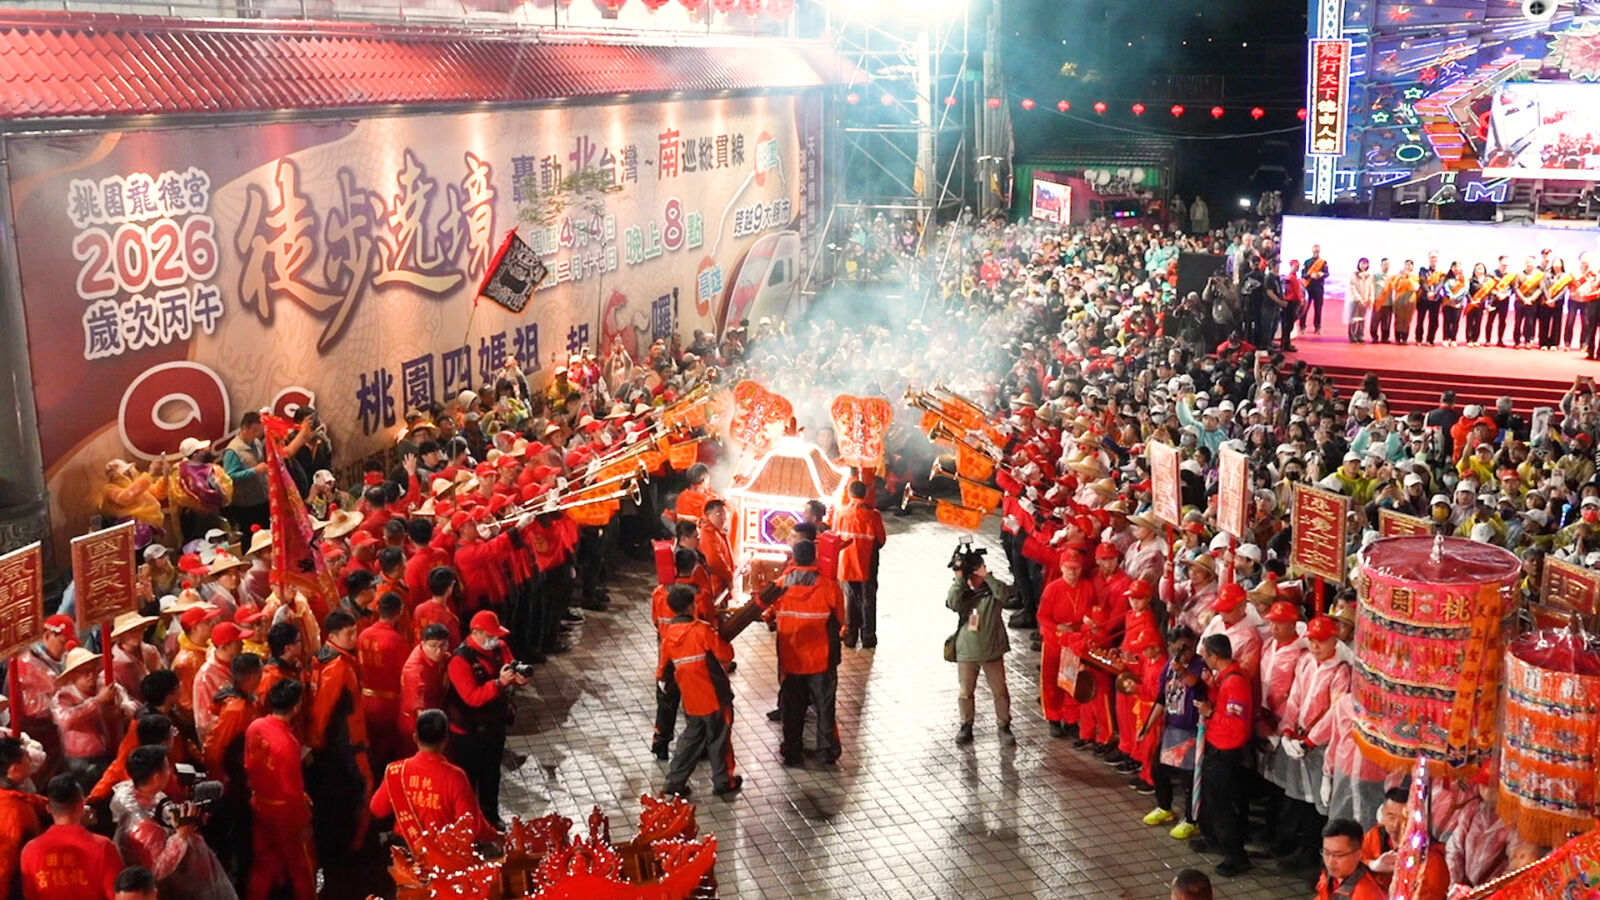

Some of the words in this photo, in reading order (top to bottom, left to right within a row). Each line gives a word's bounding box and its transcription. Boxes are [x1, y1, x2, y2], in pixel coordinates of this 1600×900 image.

[71, 169, 208, 223] 桃園龍德宮
[734, 201, 789, 235] 跨越9大縣市
[76, 217, 216, 294] 2026
[625, 199, 702, 262] 晚上8點
[538, 247, 618, 288] 曆二月十七日
[698, 267, 722, 300] 高雄
[87, 288, 222, 356] 歲次丙午
